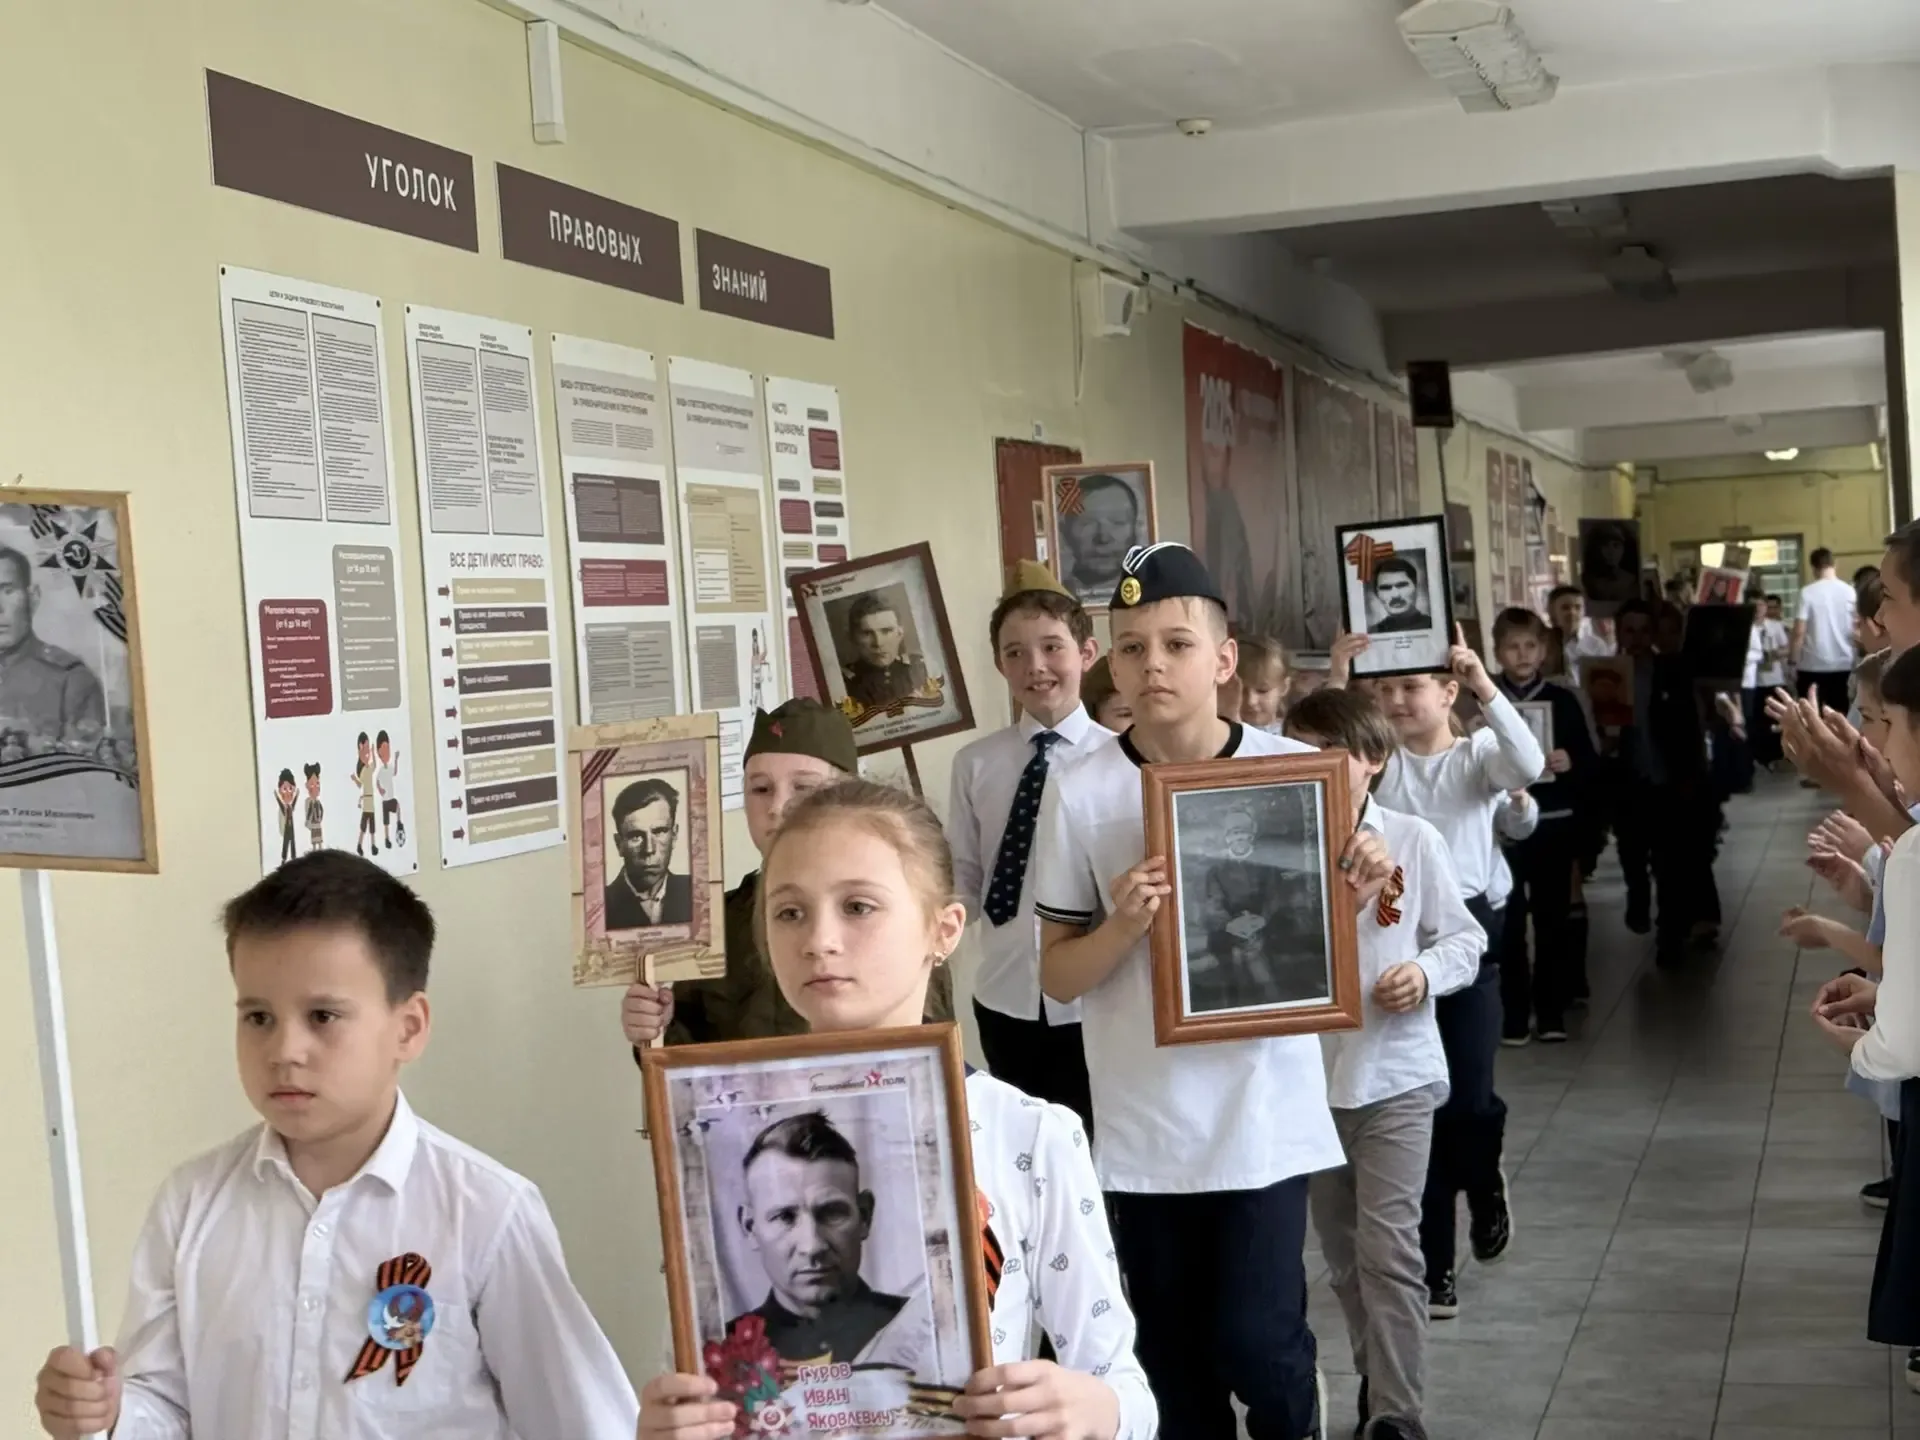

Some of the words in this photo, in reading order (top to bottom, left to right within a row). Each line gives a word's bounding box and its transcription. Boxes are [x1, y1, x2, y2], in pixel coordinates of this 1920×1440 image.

[365, 152, 458, 212] УГОЛОК
[549, 209, 643, 266] ПРАВОВЫХ
[712, 262, 769, 303] ЗНАНИЙ
[449, 551, 466, 568] ВСЕ
[467, 552, 489, 571] ДЕТИ
[490, 553, 517, 568] ИМЕЮТ
[799, 1363, 852, 1383] ГУРОВ
[803, 1387, 849, 1406] ИВАН
[807, 1410, 893, 1430] ЯКОВЛЕВИЧ
